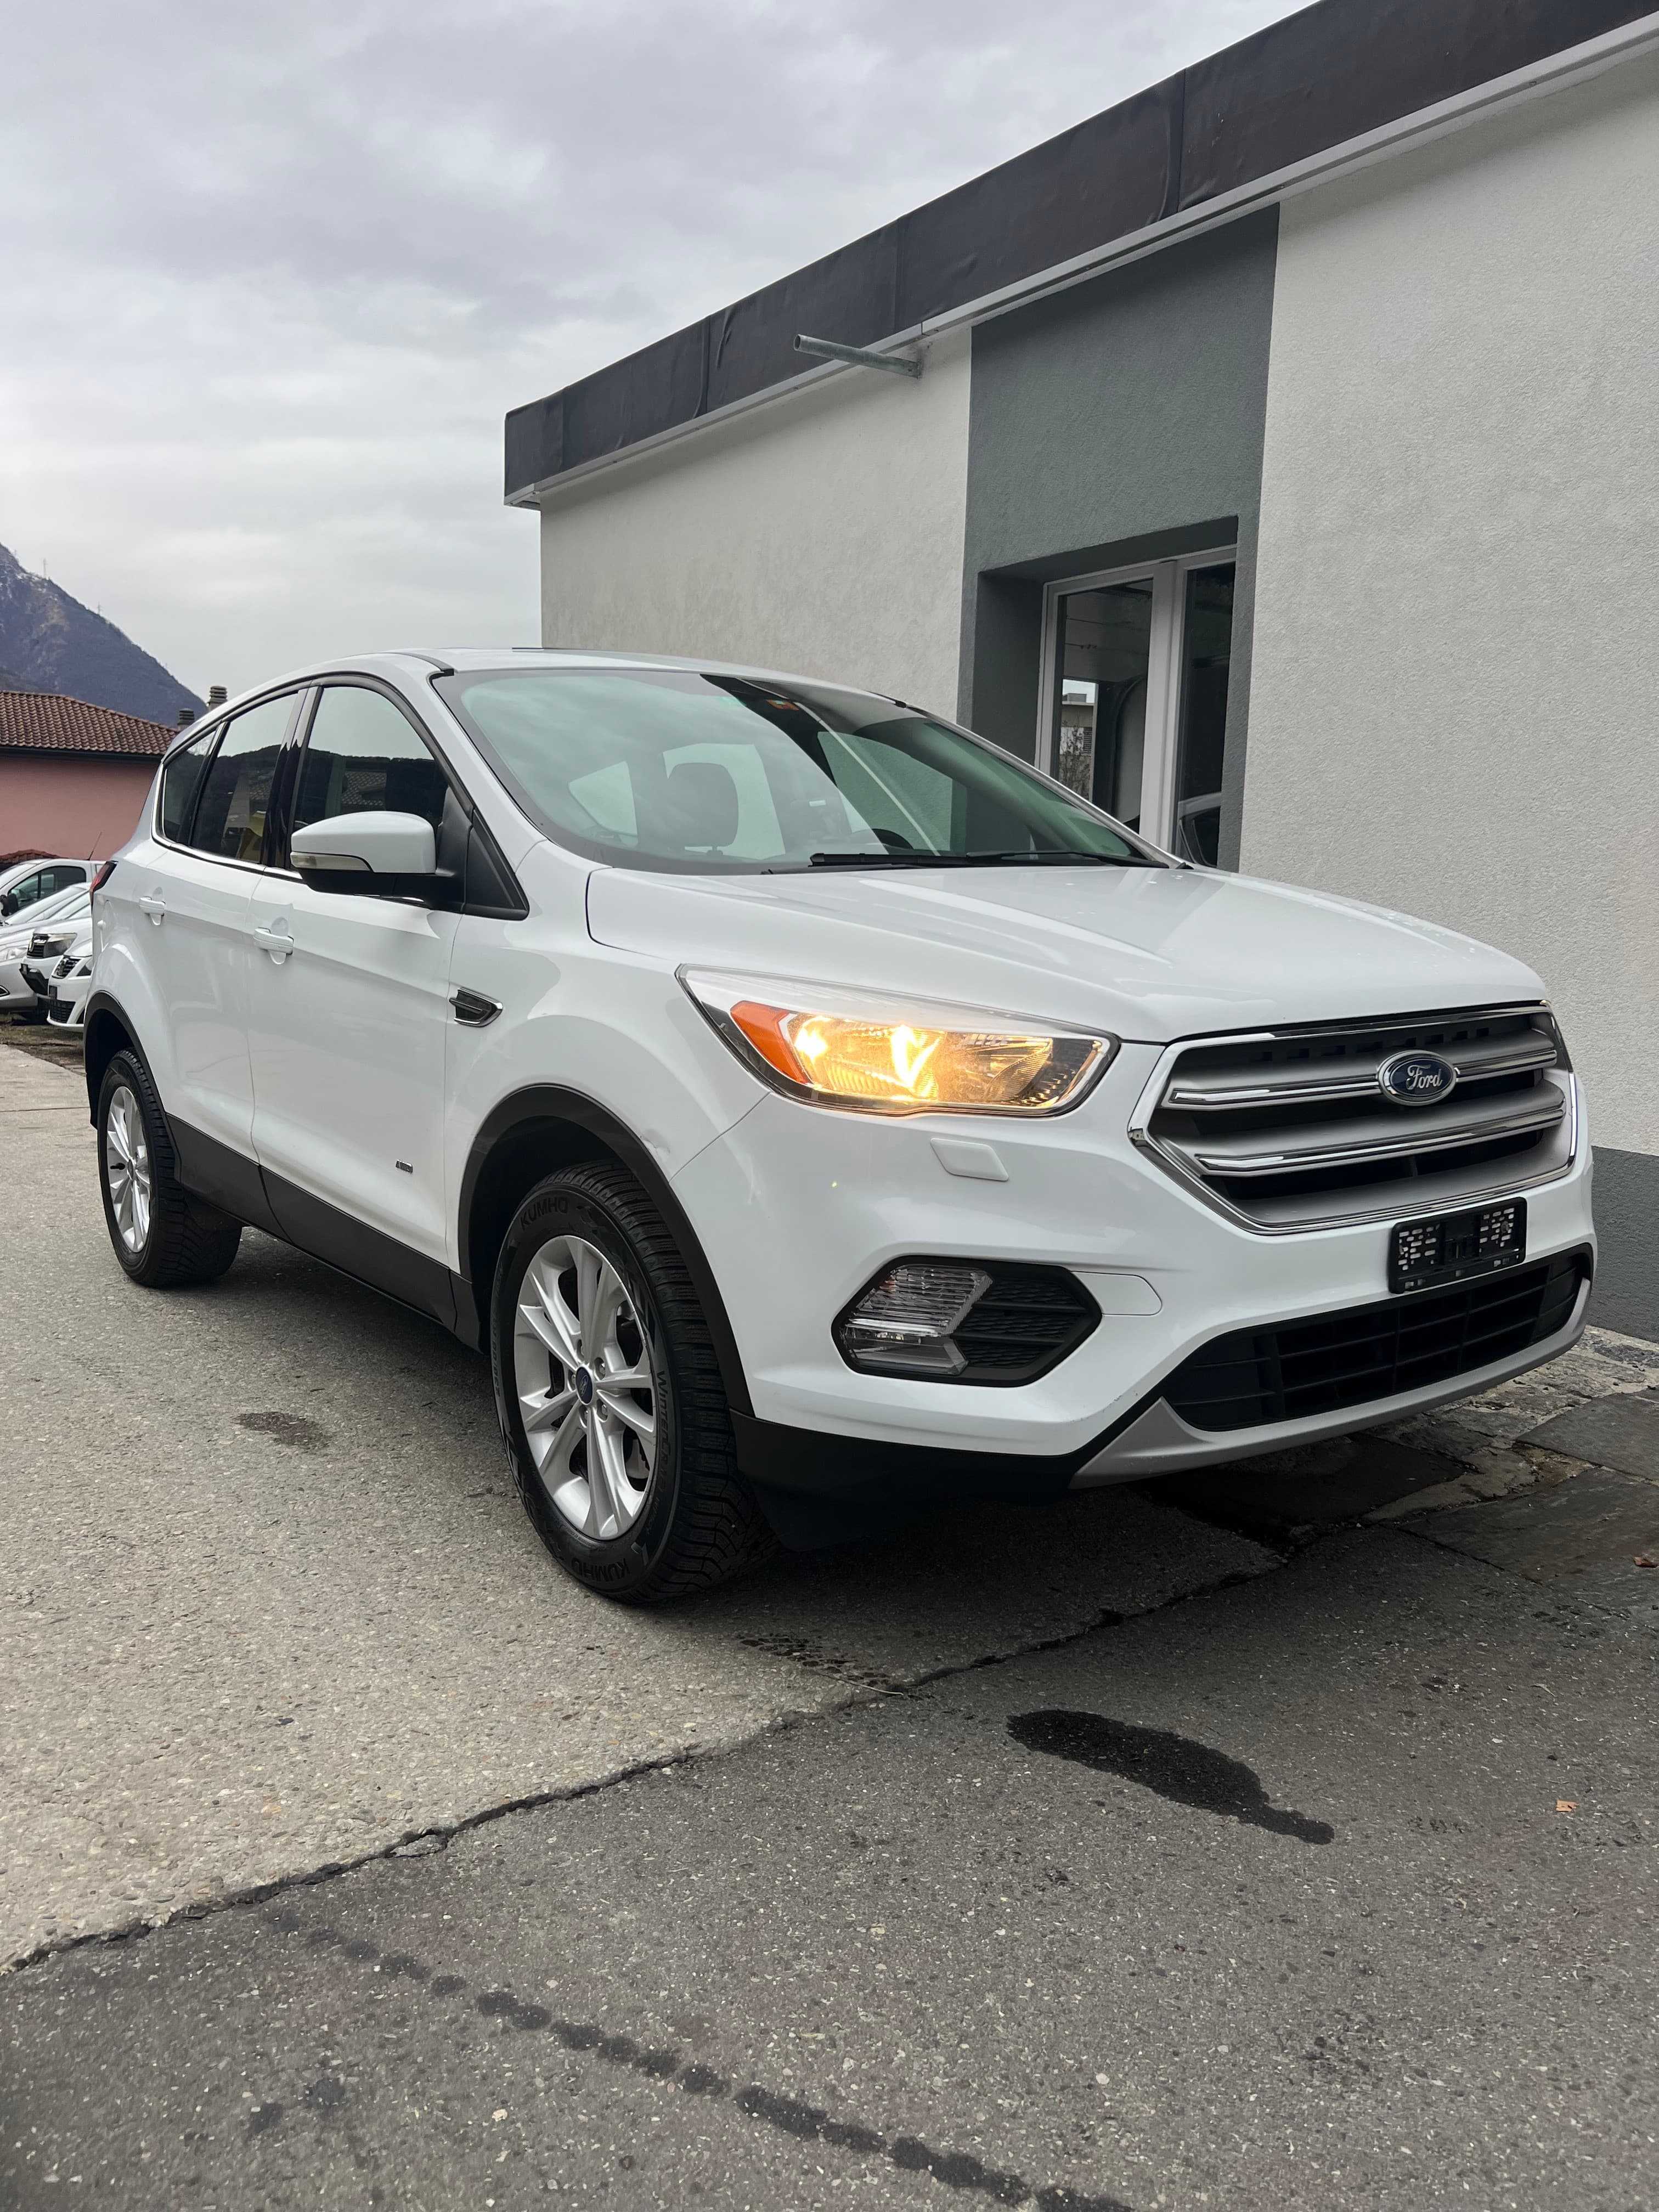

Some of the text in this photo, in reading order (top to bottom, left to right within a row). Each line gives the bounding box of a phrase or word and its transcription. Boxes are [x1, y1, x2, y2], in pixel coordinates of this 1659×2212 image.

[1406, 1064, 1444, 1090] Ford
[520, 1197, 568, 1231] KUMHO
[571, 1557, 630, 1582] KUMHO
